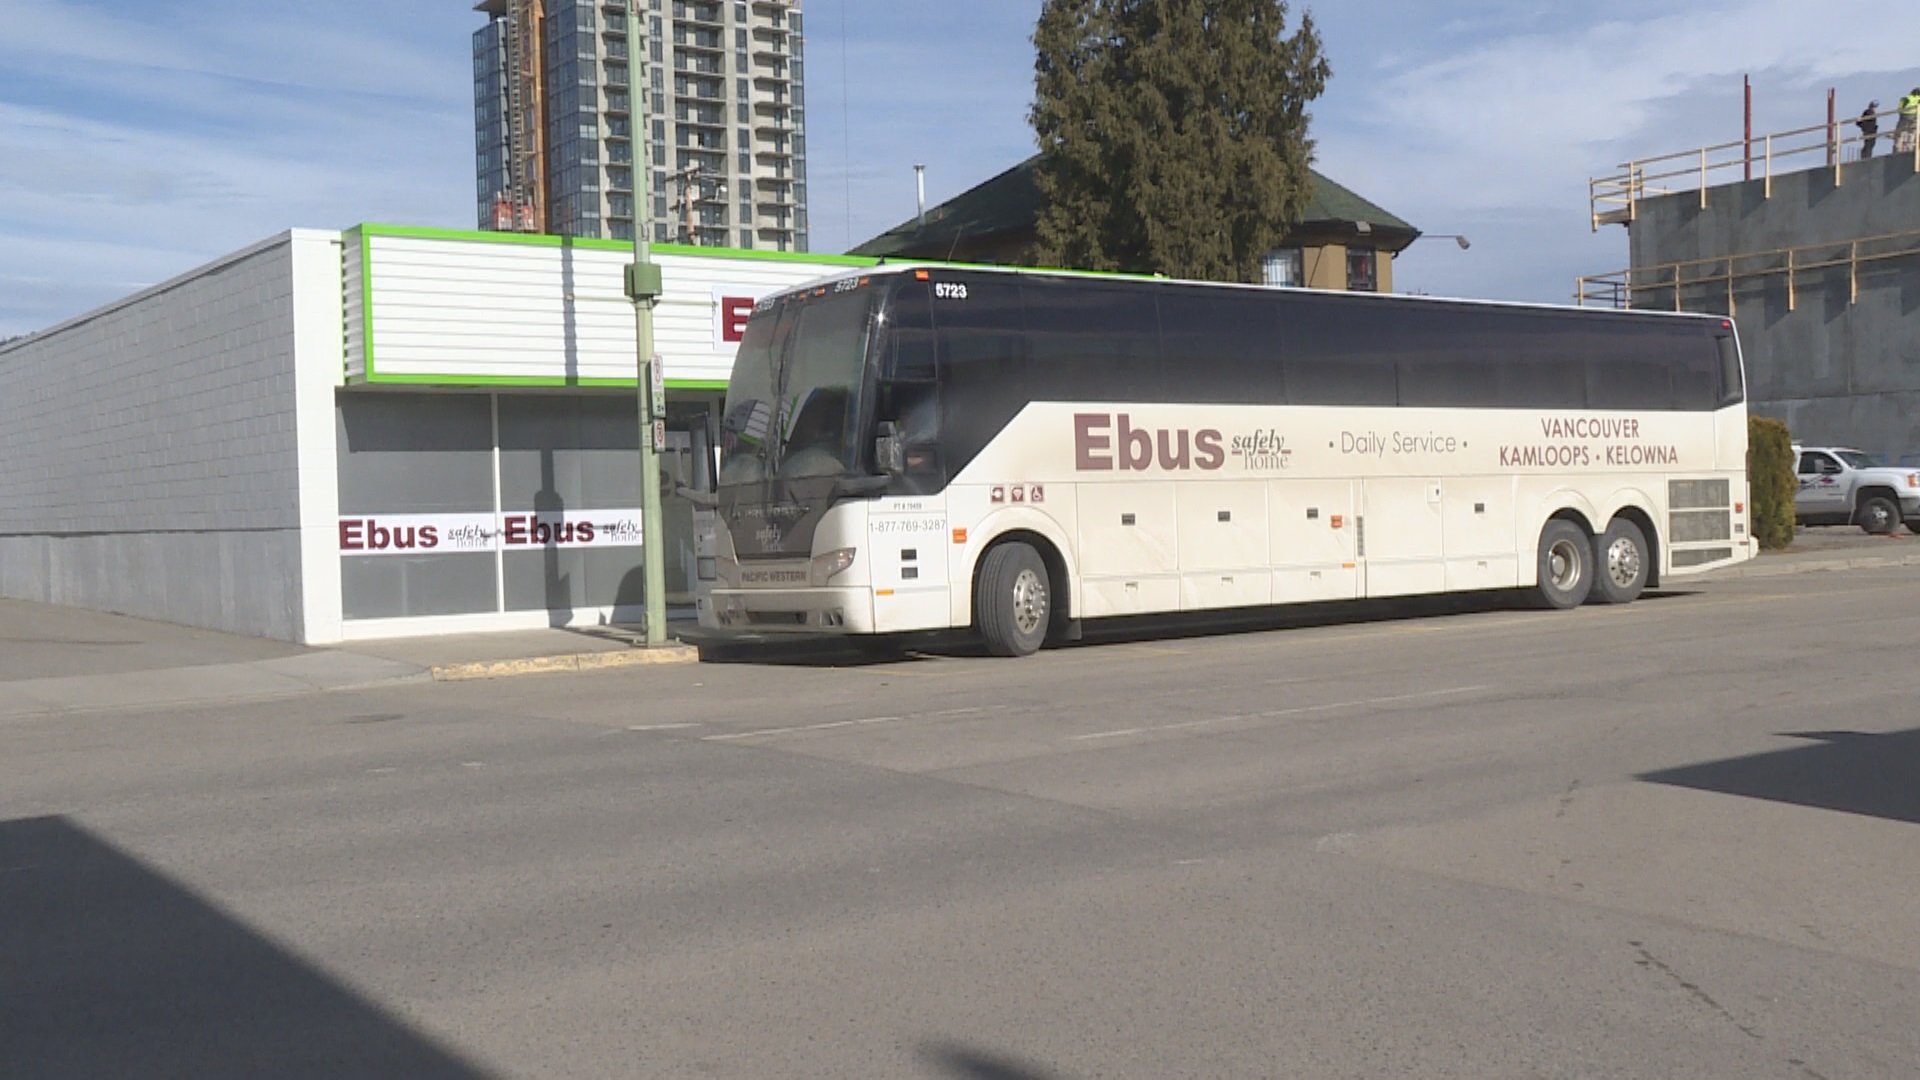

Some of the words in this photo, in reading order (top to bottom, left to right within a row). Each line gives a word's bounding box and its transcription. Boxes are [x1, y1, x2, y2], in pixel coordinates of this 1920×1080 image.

[935, 283, 968, 298] 5723
[1541, 418, 1640, 438] VANCOUVER
[1074, 413, 1225, 471] Ebus
[1231, 429, 1285, 455] safely
[1341, 431, 1386, 458] Daily
[1392, 431, 1456, 454] Service
[1244, 453, 1289, 470] home
[1499, 445, 1590, 466] KAMLOOPS
[1606, 445, 1679, 465] KELOWNA
[338, 519, 439, 550] Ebus
[448, 524, 487, 539] safely
[504, 515, 595, 544] Ebus
[603, 519, 638, 534] safely
[869, 519, 946, 532] 1-877-769-3287
